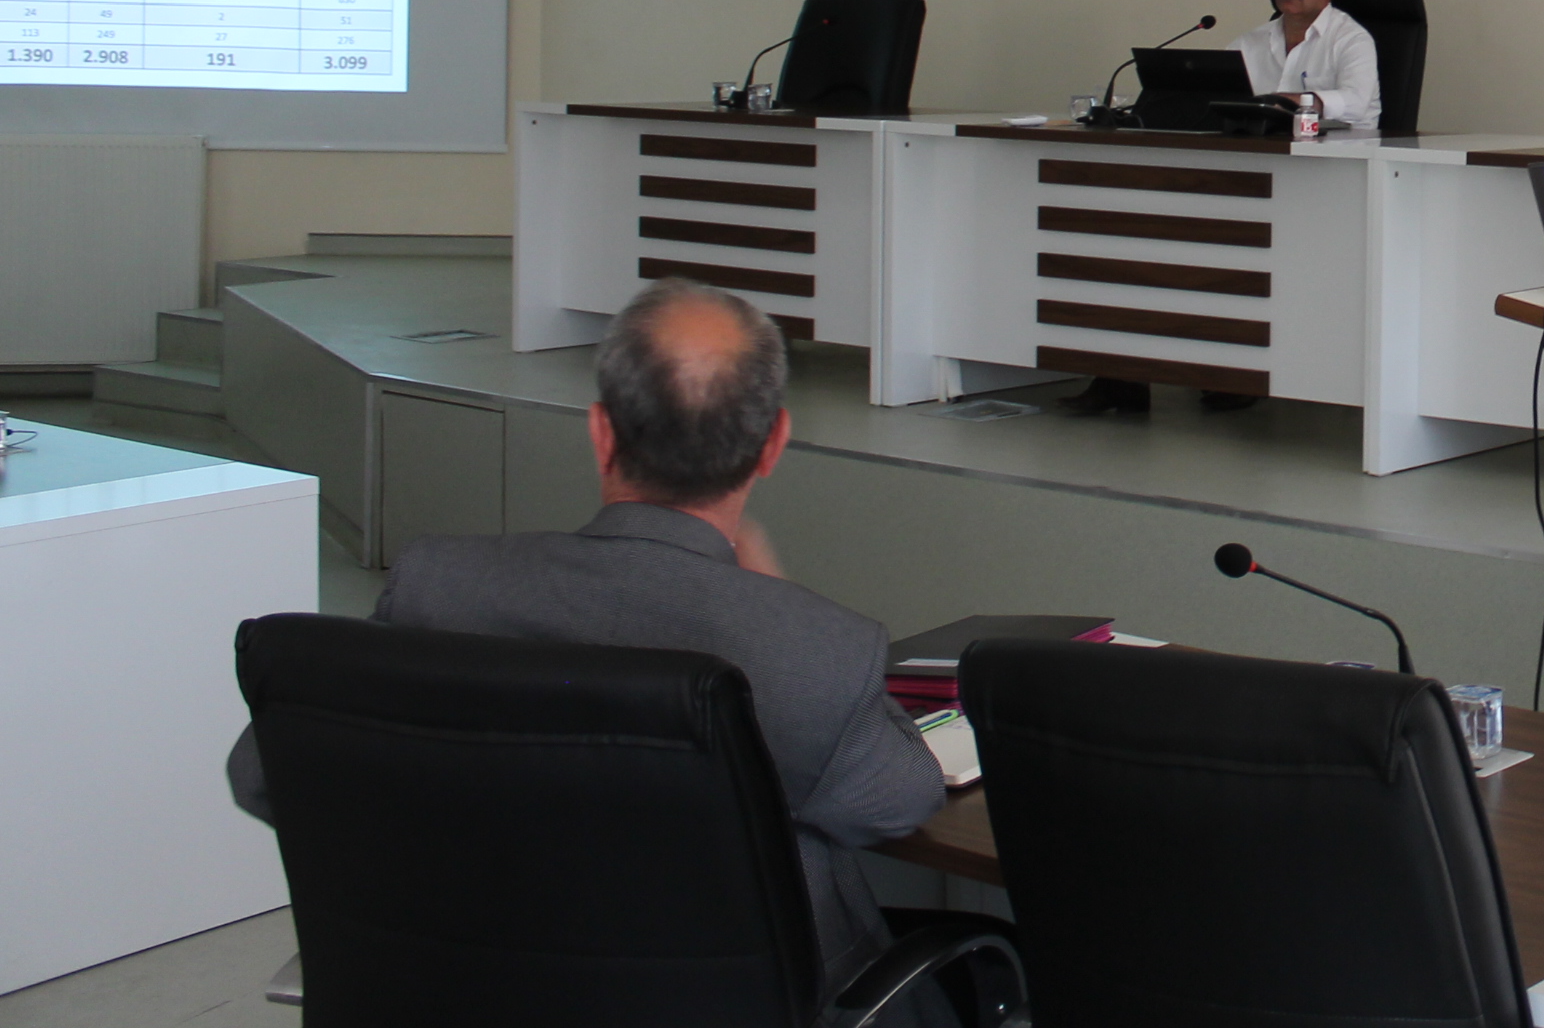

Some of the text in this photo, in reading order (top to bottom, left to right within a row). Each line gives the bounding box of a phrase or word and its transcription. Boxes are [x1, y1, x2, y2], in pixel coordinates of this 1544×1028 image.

[23, 7, 37, 17] 24
[99, 9, 113, 19] 49
[340, 15, 352, 26] 51
[21, 28, 40, 38] 113
[96, 29, 116, 39] 249
[214, 32, 228, 42] 27
[336, 35, 355, 46] 276
[7, 48, 54, 63] 1.390
[82, 49, 129, 65] 2.908
[206, 52, 236, 67] 191
[323, 55, 368, 70] 3.099
